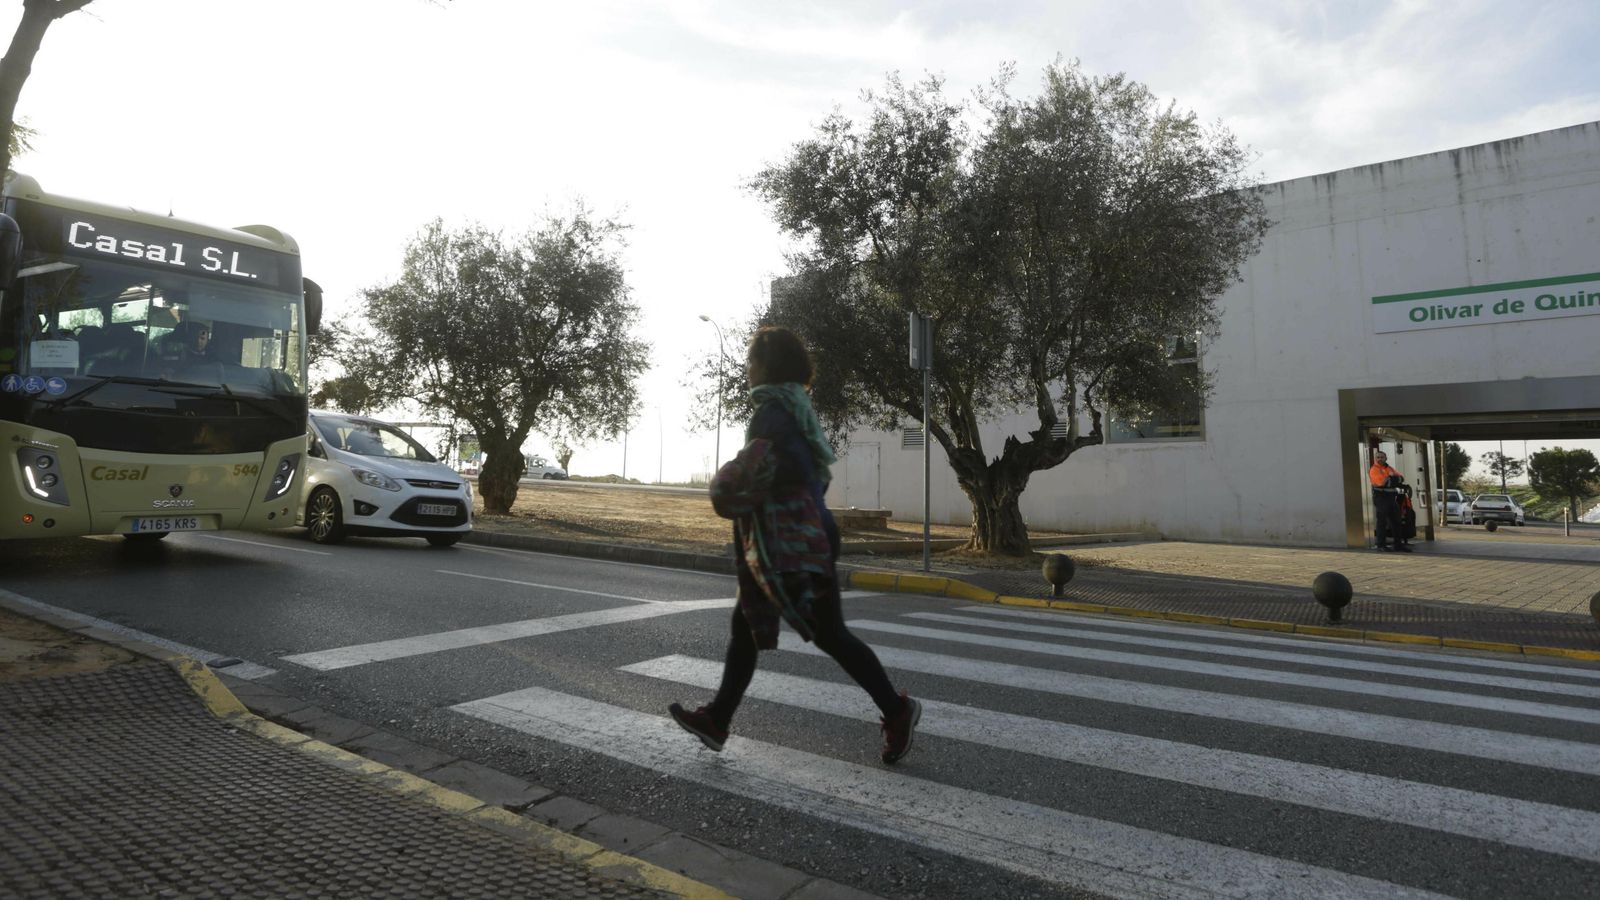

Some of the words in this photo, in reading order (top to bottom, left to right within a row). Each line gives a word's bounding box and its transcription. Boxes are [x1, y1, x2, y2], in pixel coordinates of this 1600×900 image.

[68, 221, 186, 267] Casal
[200, 246, 258, 279] S.L.
[1408, 303, 1484, 323] Olivar
[1492, 298, 1525, 315] de
[1535, 291, 1600, 311] Quin
[90, 465, 149, 481] Casal
[233, 463, 259, 477] 544
[152, 498, 195, 509] SCANIA
[140, 519, 170, 531] 4165
[175, 518, 197, 529] KRS
